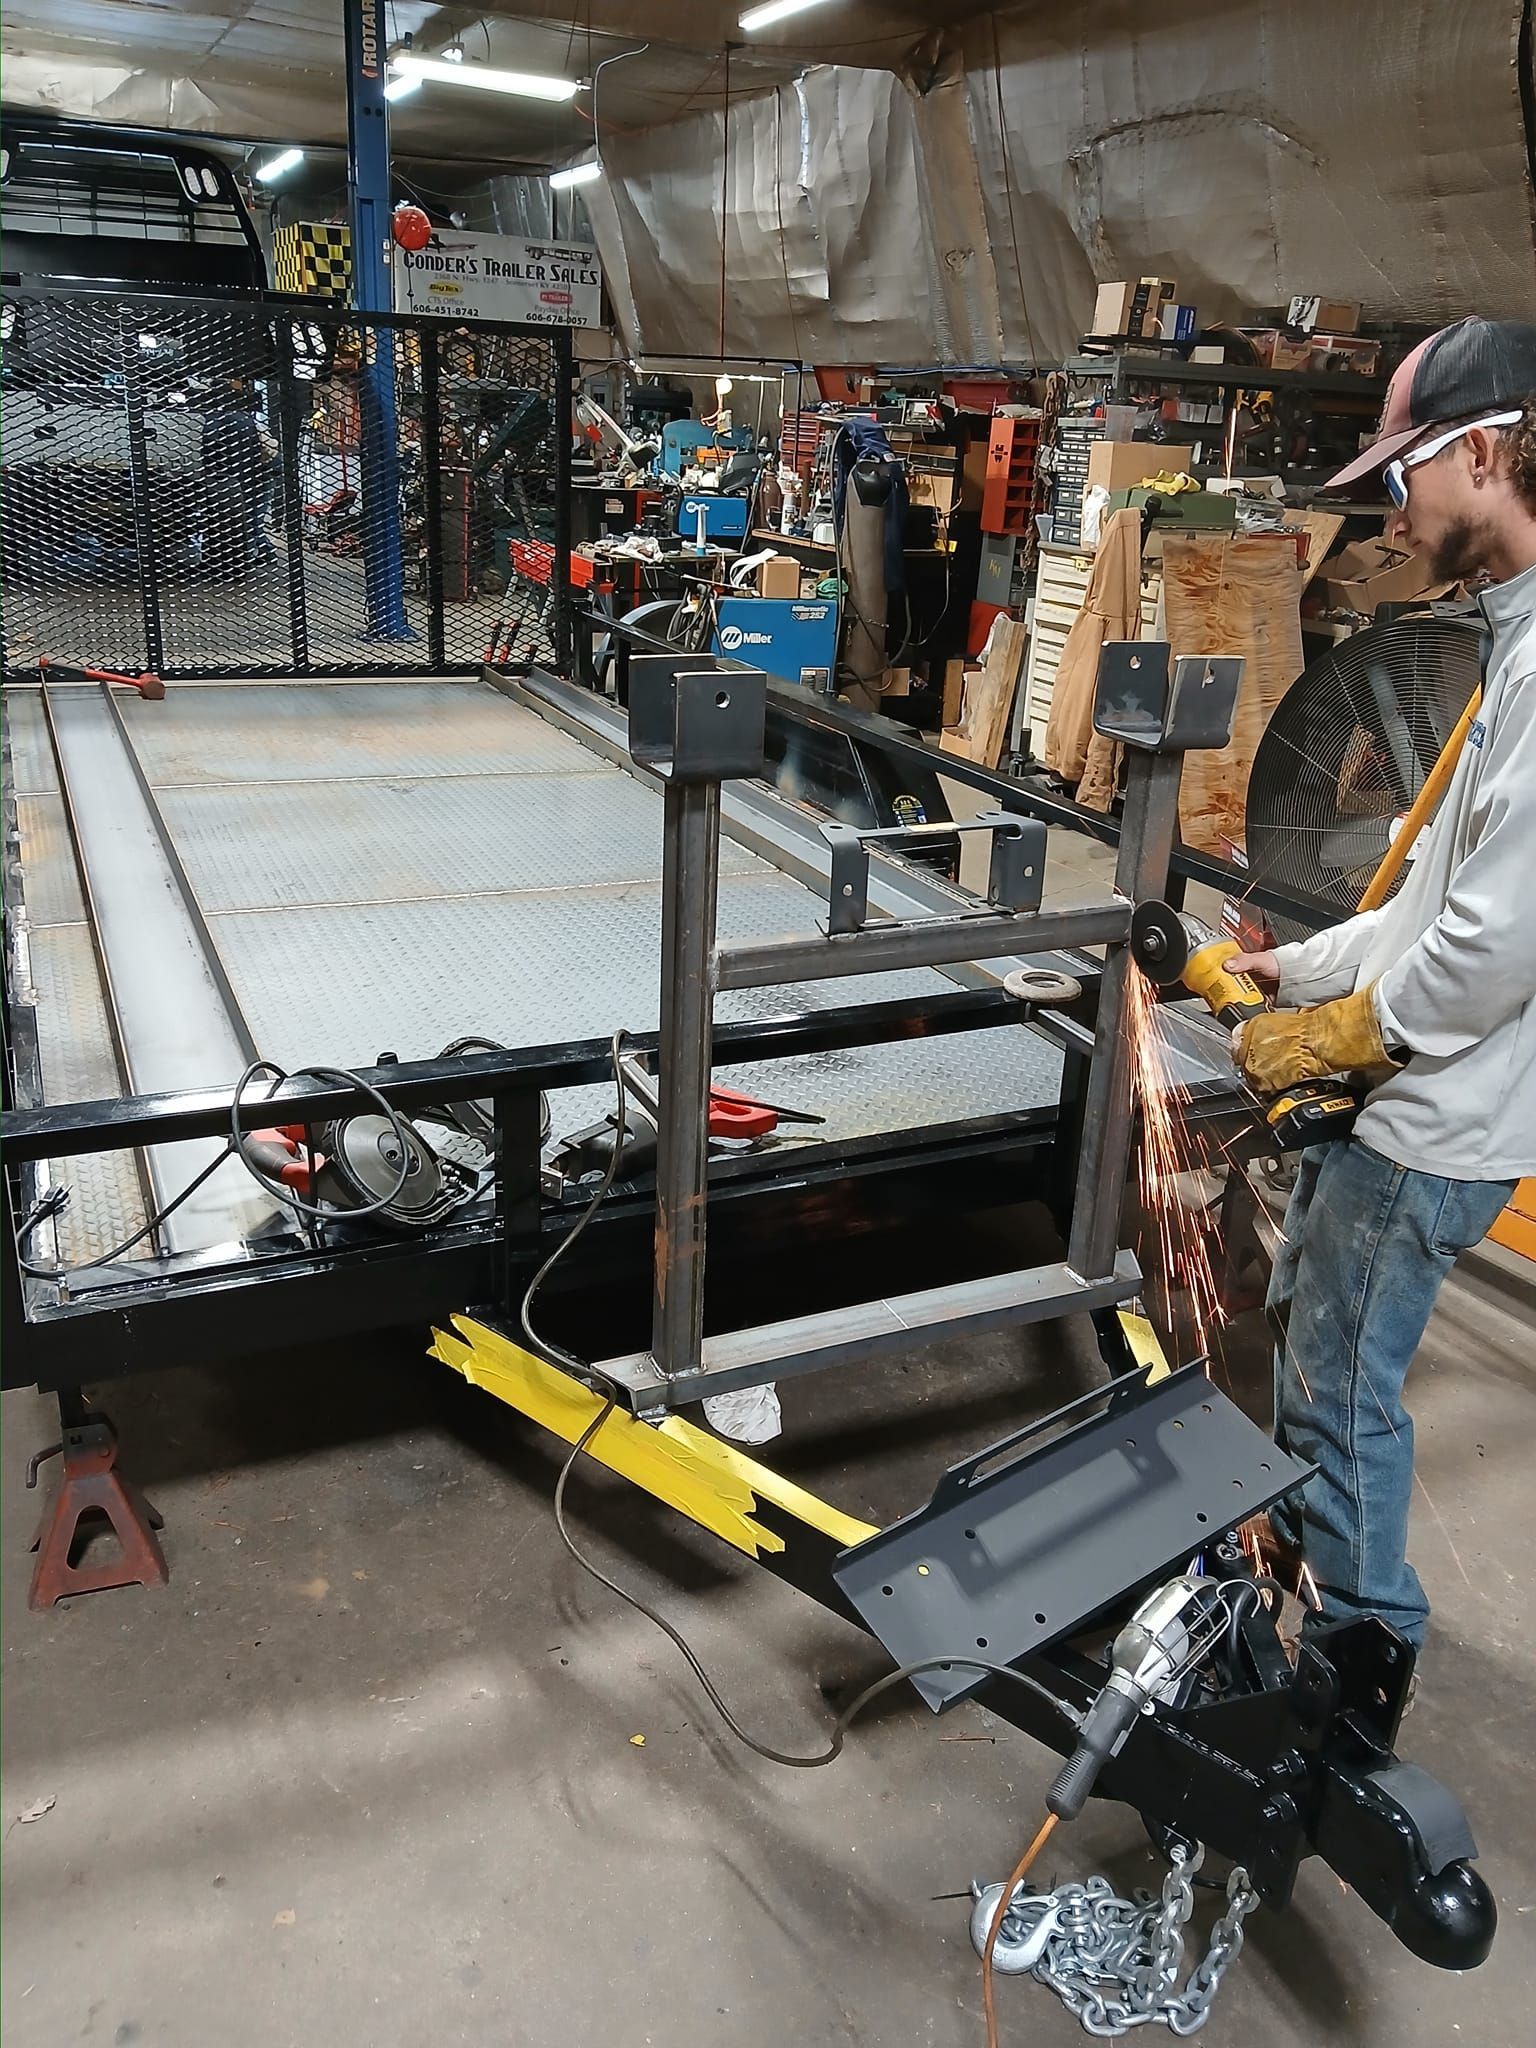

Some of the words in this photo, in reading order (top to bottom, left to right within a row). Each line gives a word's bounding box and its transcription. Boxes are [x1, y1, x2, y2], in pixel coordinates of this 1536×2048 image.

[404, 251, 478, 274] CONDER'S
[482, 257, 545, 280] TRAILER
[550, 264, 598, 285] SALES
[413, 304, 479, 317] 606-451-8742
[526, 312, 588, 326] 606-678-0057
[743, 632, 773, 644] Miller
[1239, 972, 1257, 992] WALT
